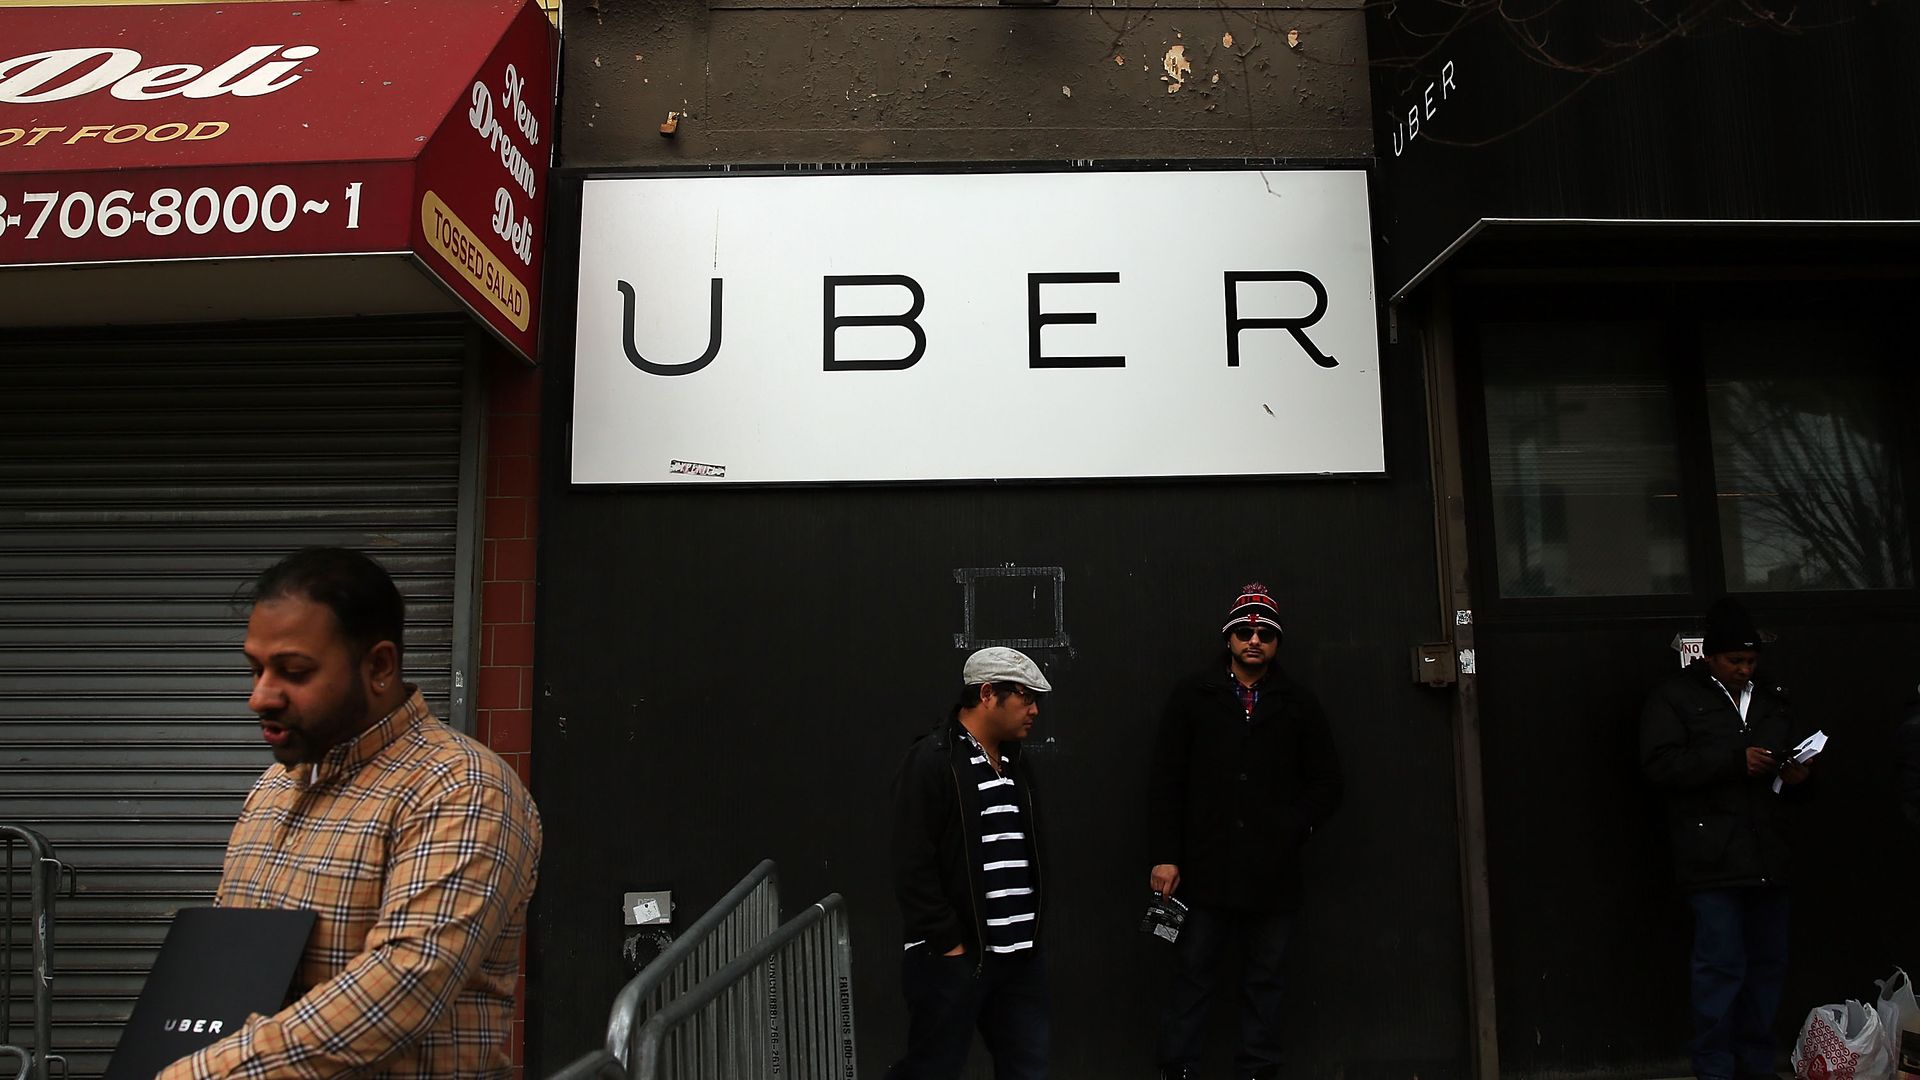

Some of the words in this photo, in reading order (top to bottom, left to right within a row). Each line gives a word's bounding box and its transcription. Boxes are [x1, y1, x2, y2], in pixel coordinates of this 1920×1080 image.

[0, 45, 319, 104] Deli
[503, 63, 539, 146] New
[1393, 60, 1456, 157] UBER
[63, 121, 230, 145] FOOD
[469, 80, 536, 199] Dream
[492, 187, 532, 265] Deli
[434, 206, 484, 281] TOSSED
[485, 263, 522, 317] SALAD
[617, 270, 1340, 377] UBER
[1684, 644, 1699, 653] NO
[164, 1018, 224, 1034] UBER
[840, 977, 851, 1034] FRIEDRICHS
[844, 1039, 854, 1080] 800-39
